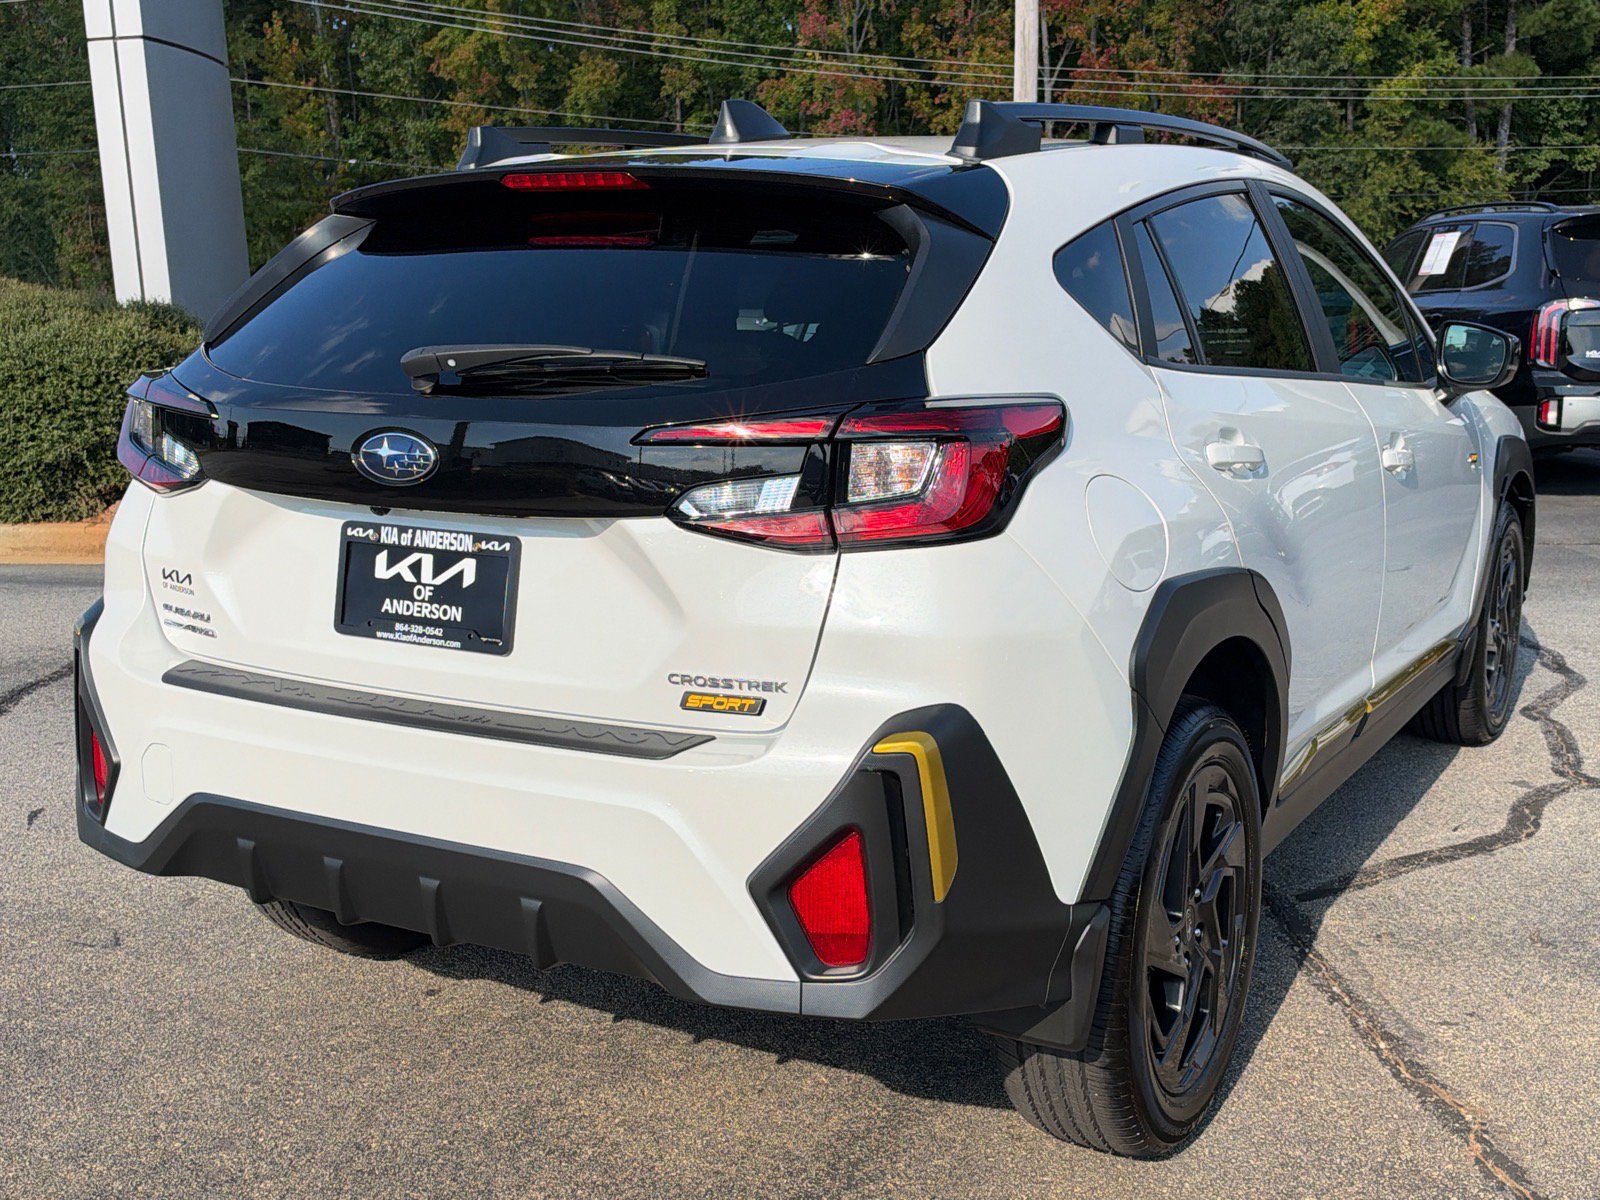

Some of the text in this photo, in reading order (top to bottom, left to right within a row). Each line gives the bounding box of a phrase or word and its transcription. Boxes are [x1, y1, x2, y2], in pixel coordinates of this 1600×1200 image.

[347, 526, 510, 552] KIA KIA of ANDERSON KIA
[162, 568, 192, 585] KIA
[374, 549, 477, 589] KIA
[413, 585, 434, 601] OF
[163, 603, 210, 623] SUBARU
[381, 598, 462, 622] ANDERSON
[394, 623, 443, 637] 864-328-0542
[376, 631, 461, 648] www.KiaofAnderson.com
[668, 673, 788, 693] CROSSTREK
[686, 694, 755, 711] SPORT
